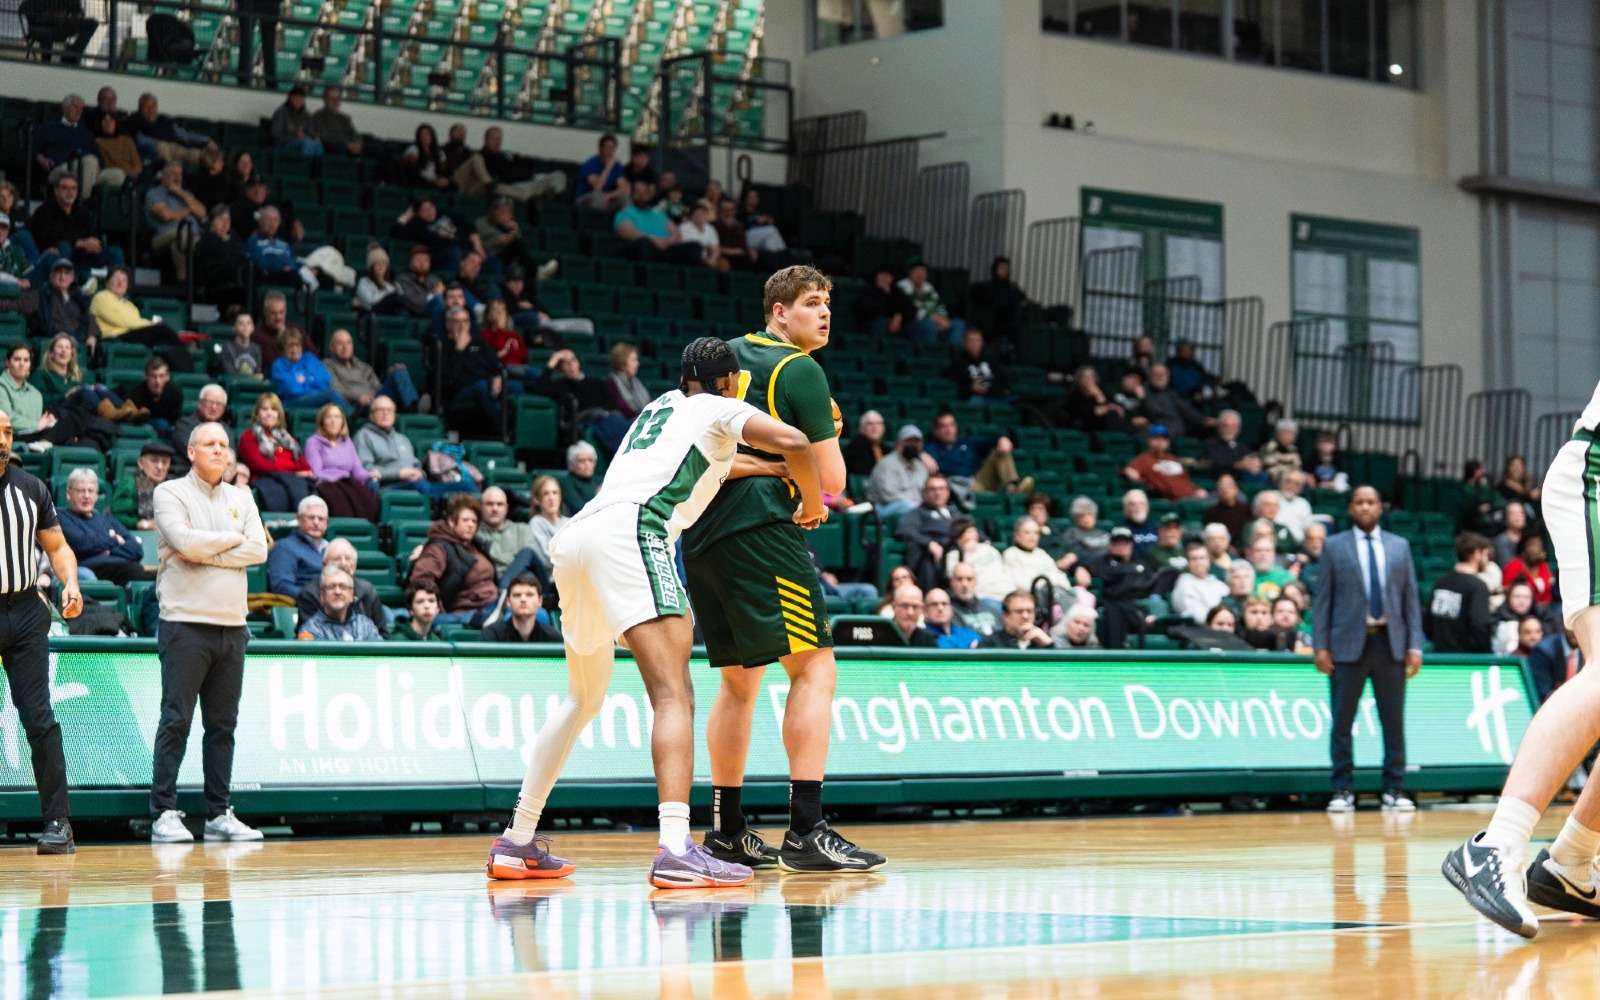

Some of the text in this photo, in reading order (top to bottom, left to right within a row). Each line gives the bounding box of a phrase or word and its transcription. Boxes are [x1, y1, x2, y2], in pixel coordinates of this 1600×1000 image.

[622, 406, 674, 455] 13
[268, 660, 560, 769] Holiday
[766, 681, 1377, 753] nghamton Downto
[278, 757, 307, 775] AN
[358, 756, 425, 774] HOTEL
